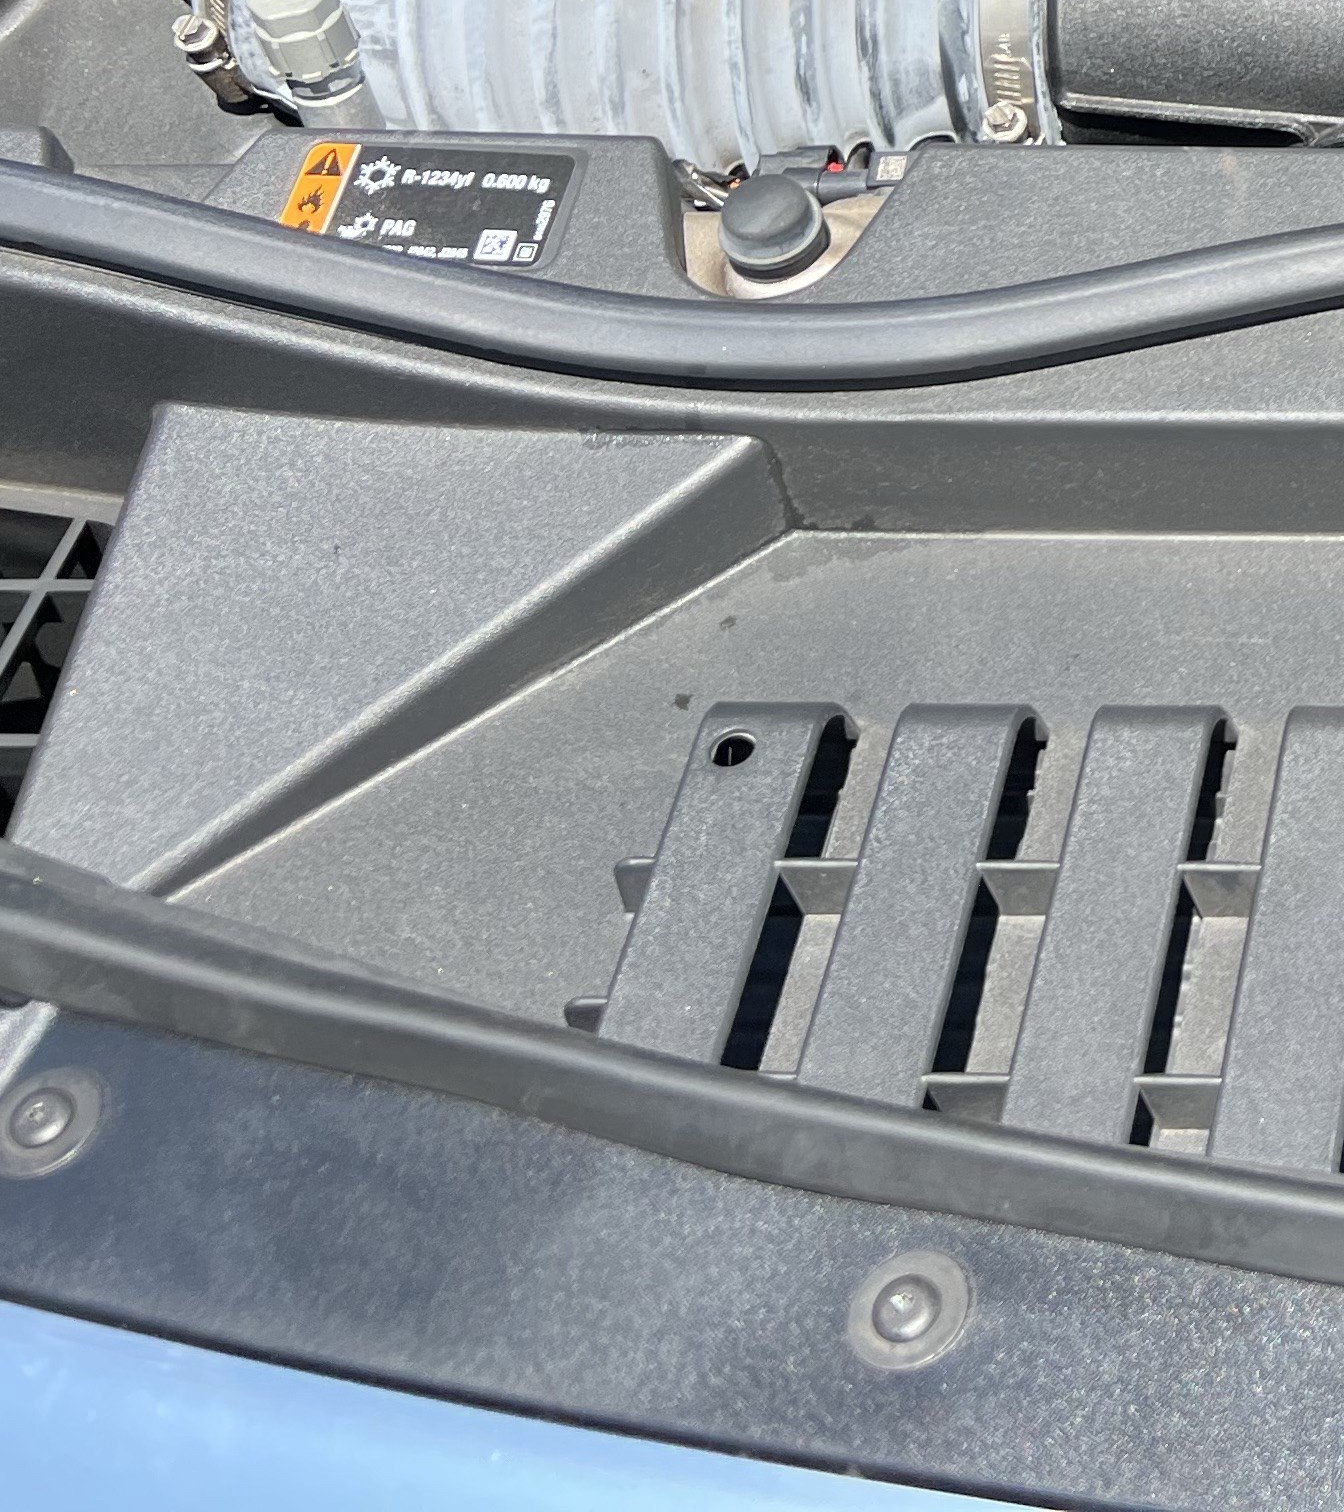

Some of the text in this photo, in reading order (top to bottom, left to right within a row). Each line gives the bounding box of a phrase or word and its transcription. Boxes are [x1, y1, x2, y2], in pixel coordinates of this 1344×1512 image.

[401, 169, 475, 189] R-1234yf
[526, 174, 551, 195] kg
[379, 218, 417, 238] PAG
